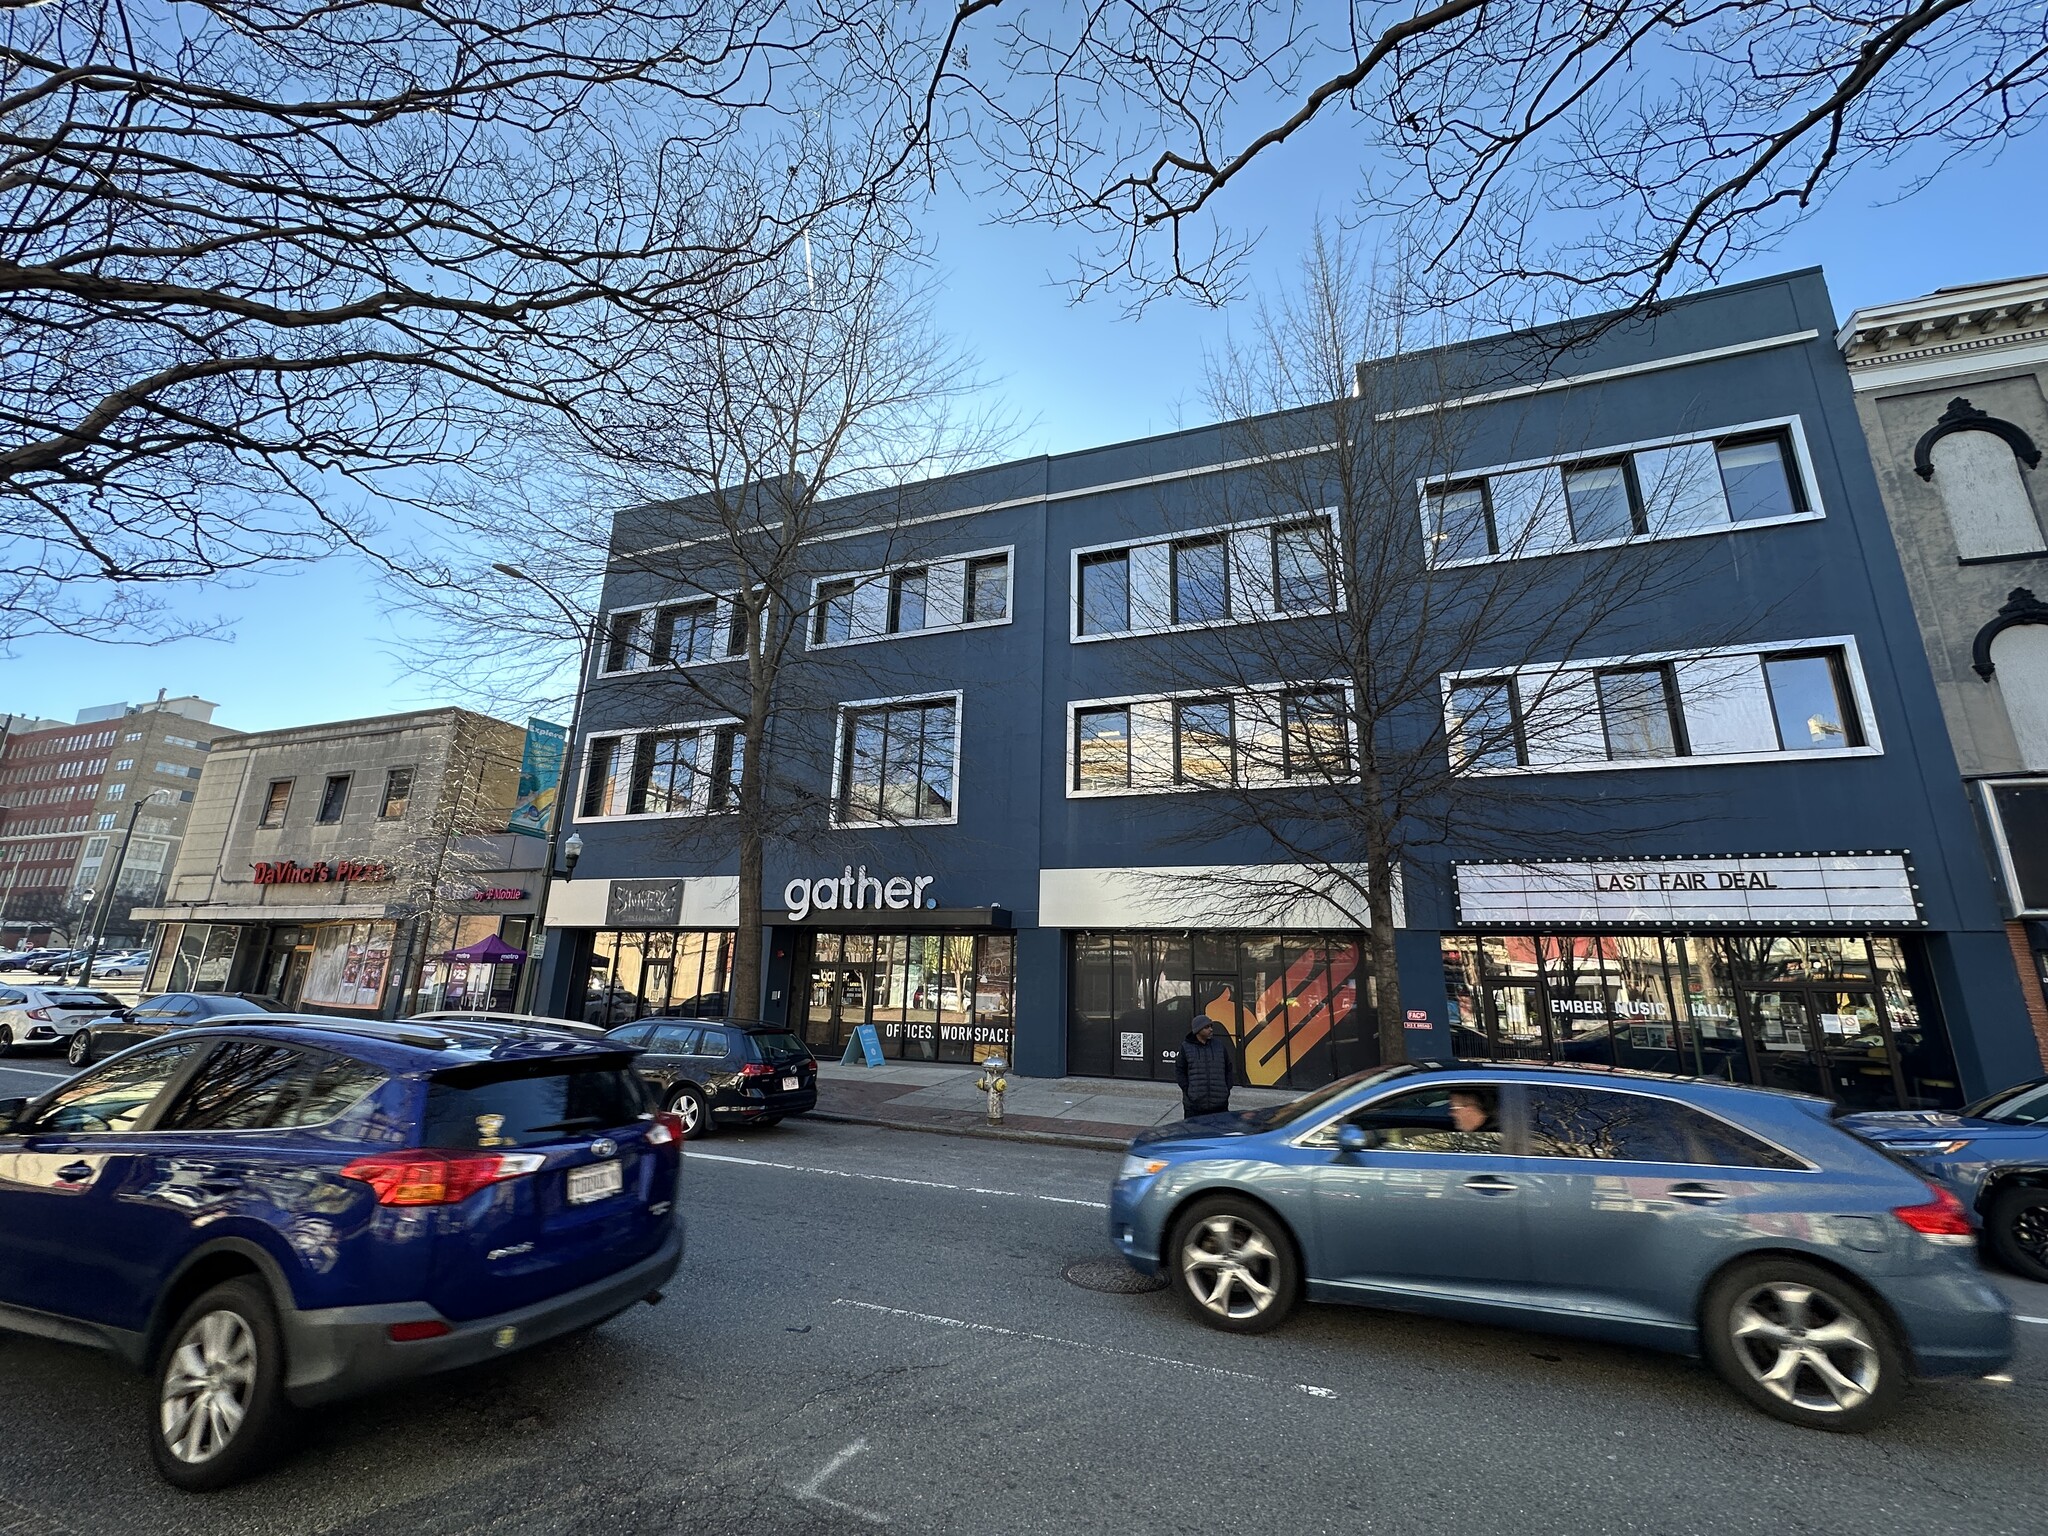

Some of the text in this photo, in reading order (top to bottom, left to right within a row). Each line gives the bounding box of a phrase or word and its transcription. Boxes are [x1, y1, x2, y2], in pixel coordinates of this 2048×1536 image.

[254, 861, 330, 884] DaVinci's
[1595, 872, 1777, 891] LAST FAIR DEAL
[784, 865, 937, 921] gather.
[500, 953, 519, 961] metro
[452, 969, 467, 980] $25
[1551, 999, 1604, 1015] EMBER
[1615, 1001, 1667, 1016] MUSIC
